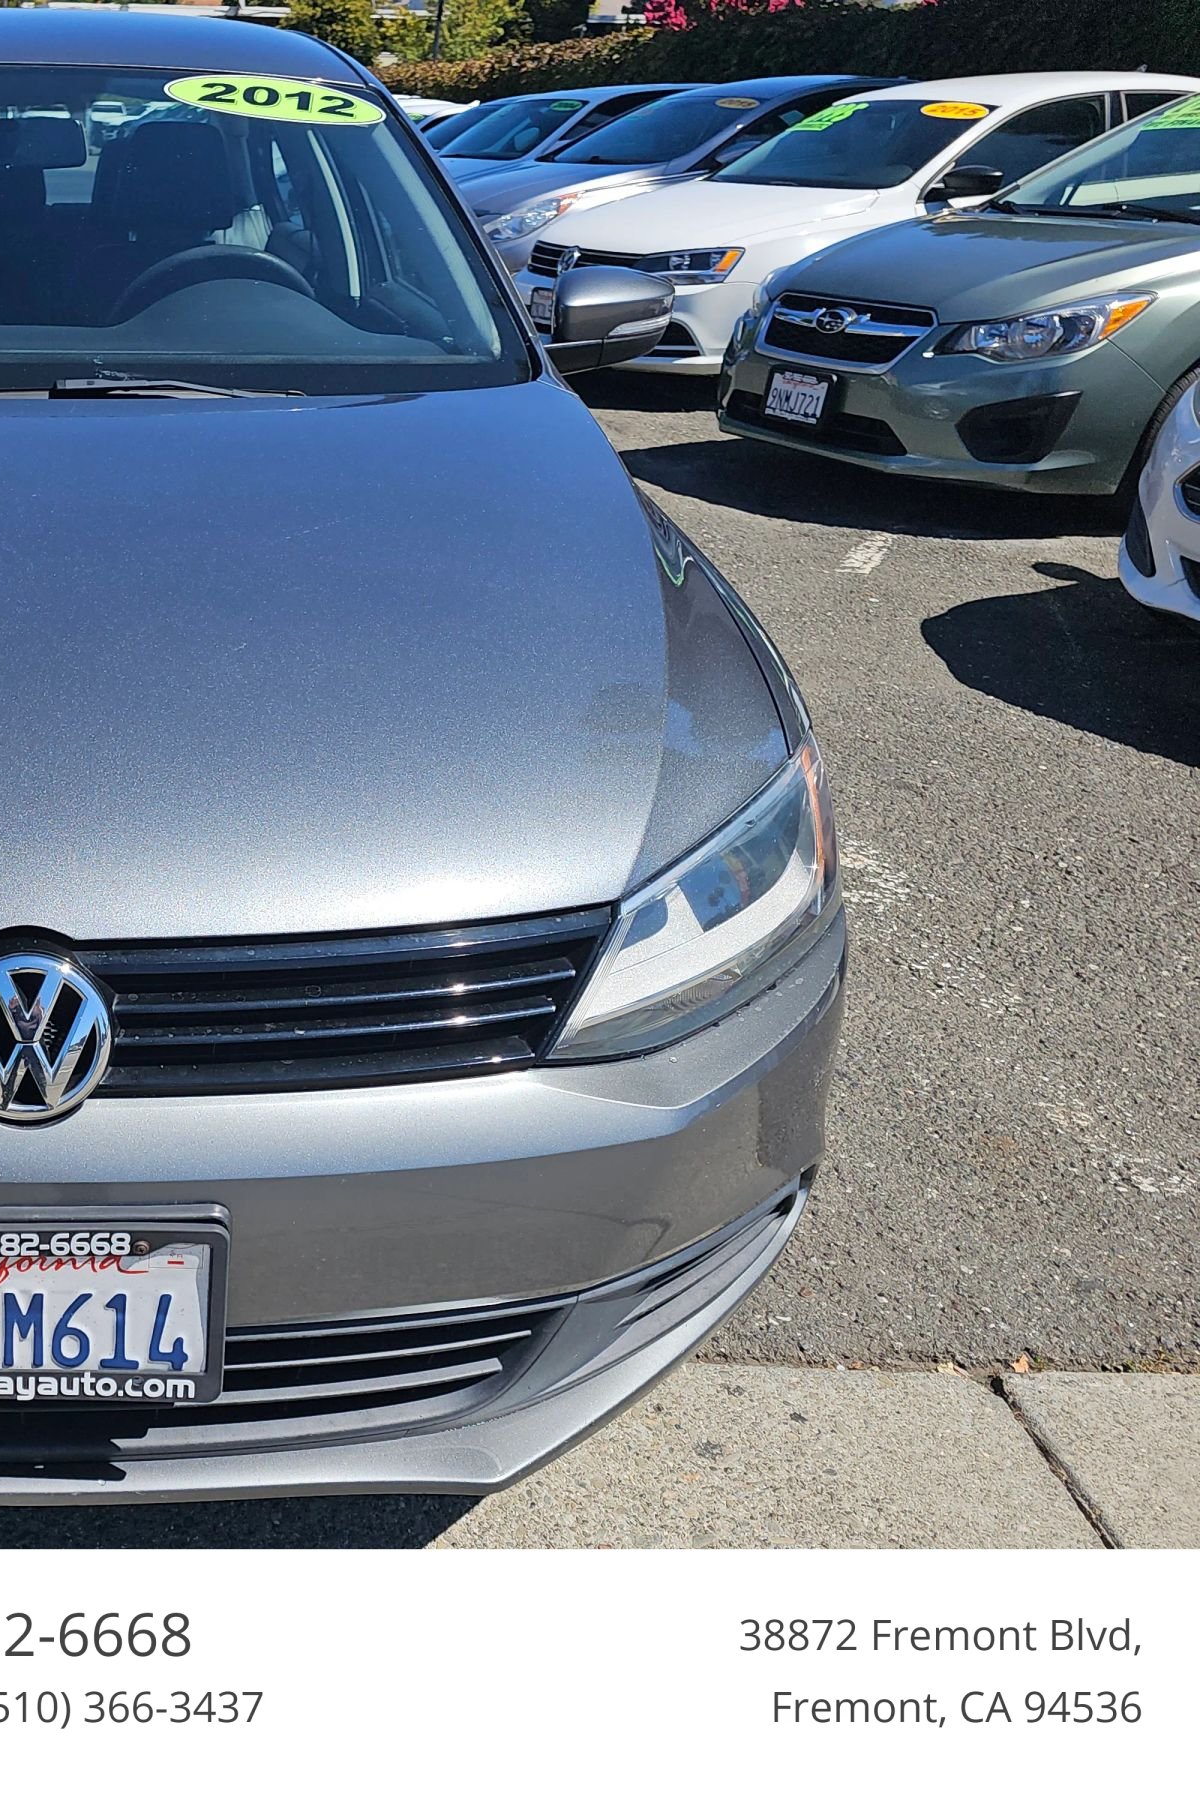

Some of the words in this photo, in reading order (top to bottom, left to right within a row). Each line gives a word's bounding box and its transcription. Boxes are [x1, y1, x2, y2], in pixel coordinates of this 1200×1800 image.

[197, 82, 358, 120] 2012
[926, 104, 984, 117] 2015
[768, 387, 821, 418] 9NMJ721
